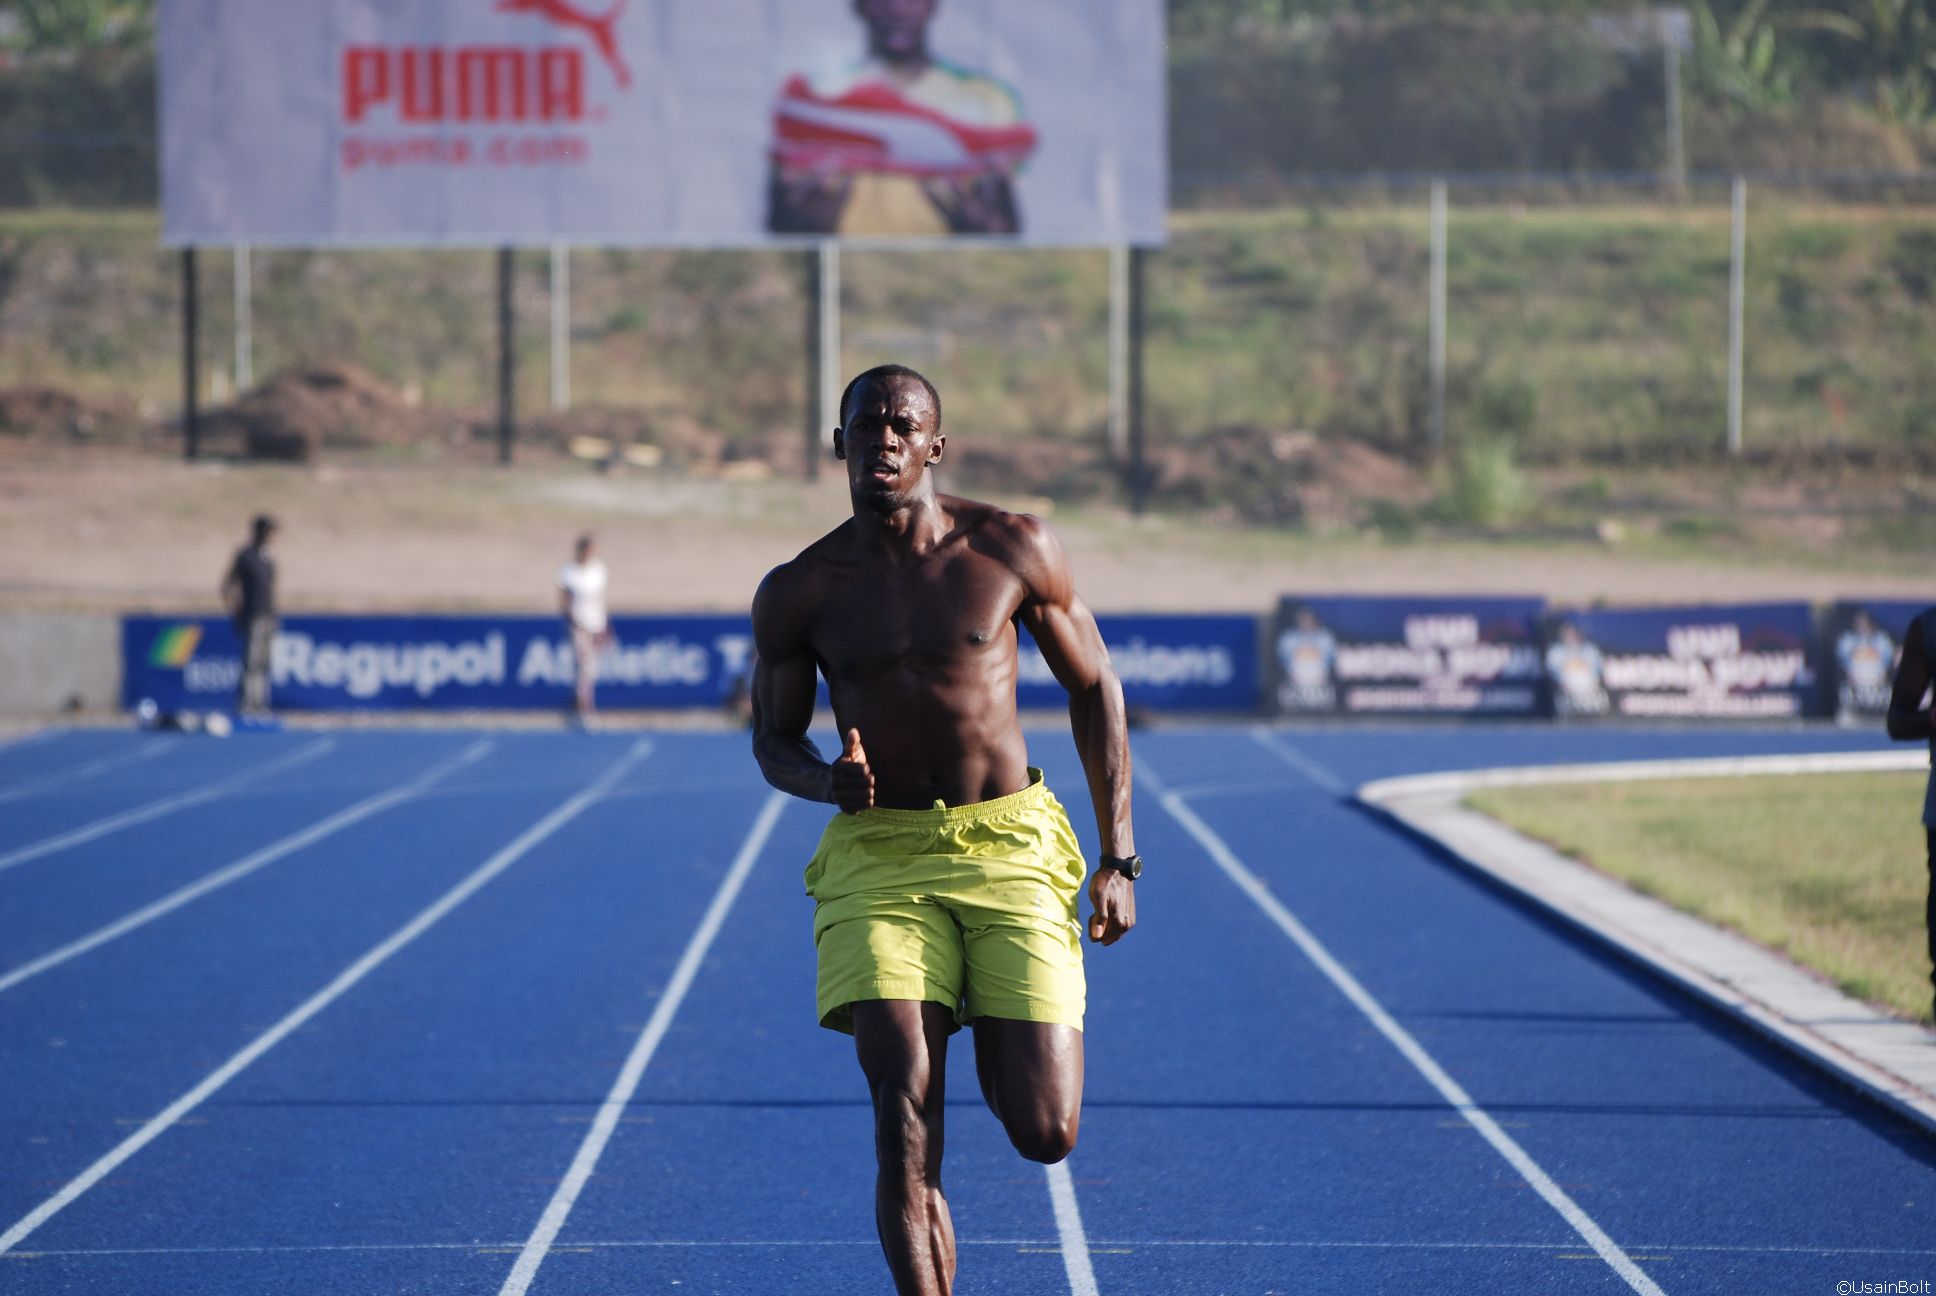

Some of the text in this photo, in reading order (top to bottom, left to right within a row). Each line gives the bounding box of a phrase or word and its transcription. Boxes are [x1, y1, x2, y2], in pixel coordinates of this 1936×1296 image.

[344, 46, 582, 120] PUMA
[342, 137, 587, 172] puma.com
[270, 631, 505, 698] Regupol
